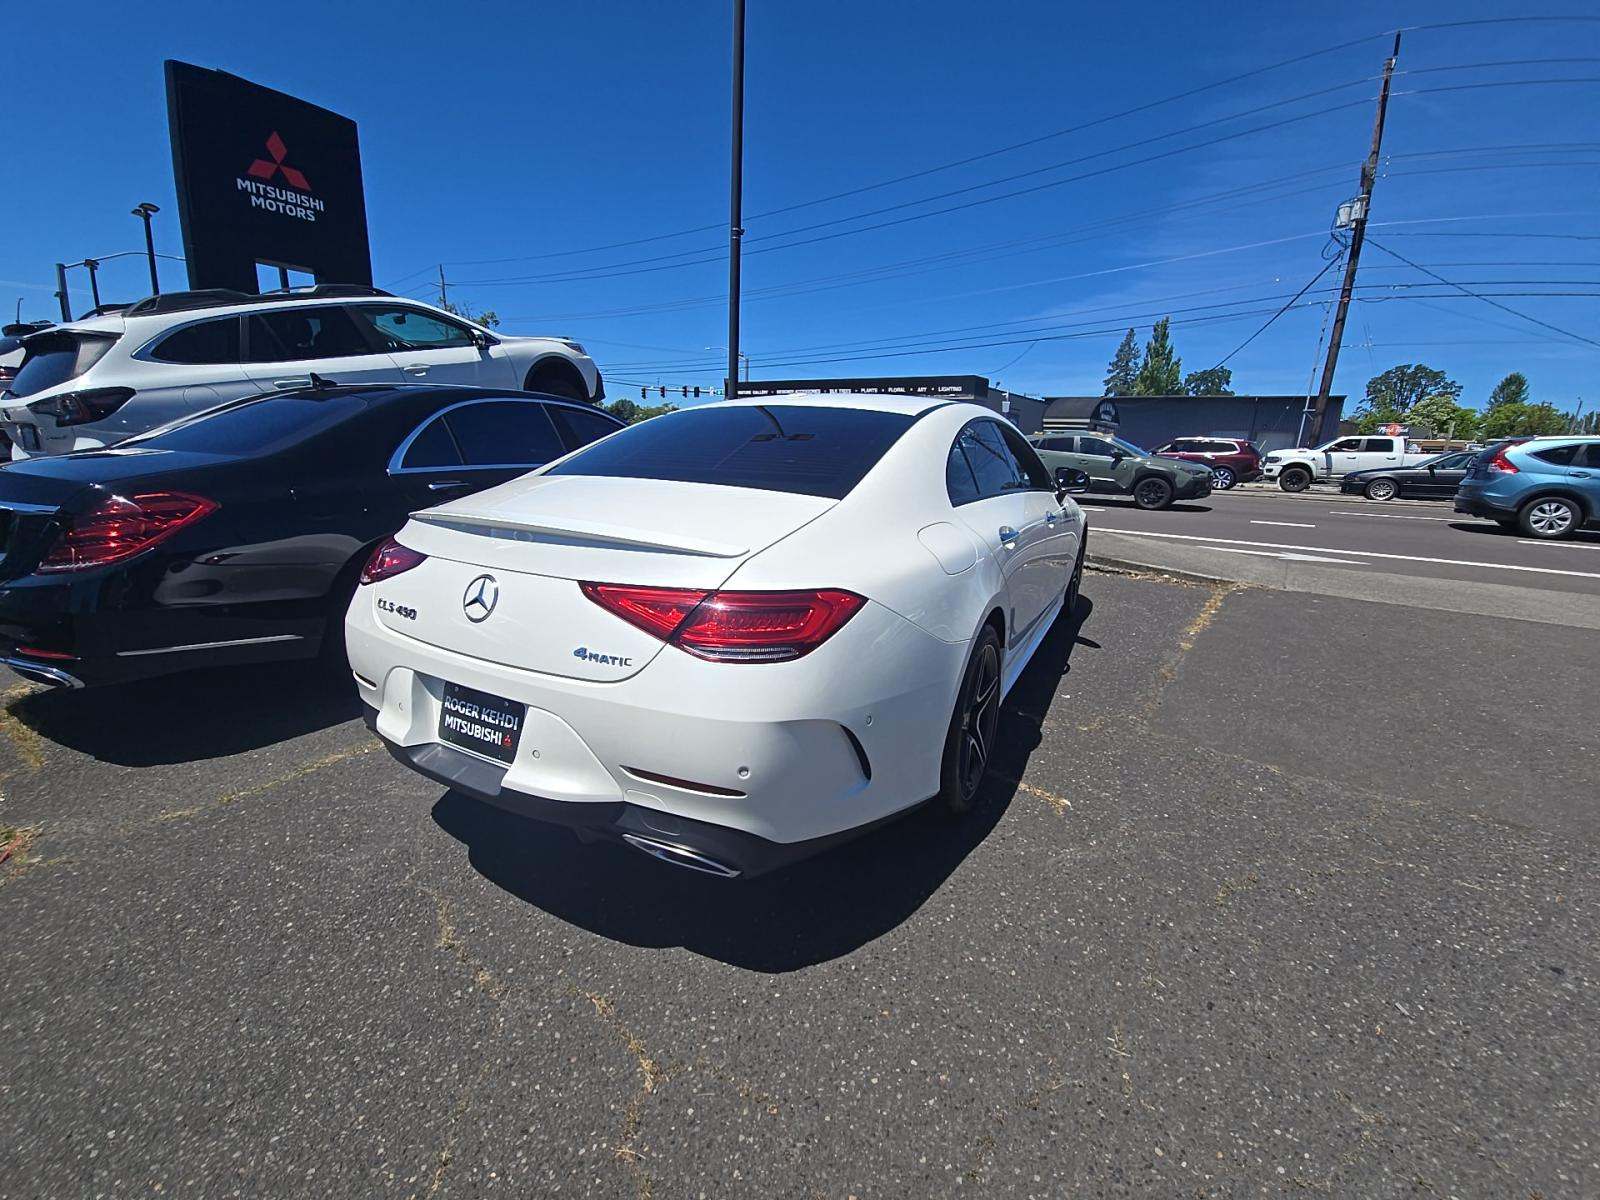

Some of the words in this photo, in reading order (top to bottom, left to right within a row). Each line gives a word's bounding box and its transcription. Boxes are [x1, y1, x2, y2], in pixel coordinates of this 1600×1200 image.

[236, 178, 325, 212] MITSUBISHI
[250, 195, 316, 222] MOTORS
[377, 597, 395, 613] CLS
[396, 605, 418, 621] 450
[573, 646, 633, 668] 4MATIC
[444, 695, 479, 719] ROGER
[444, 714, 503, 746] MITSUBISHI
